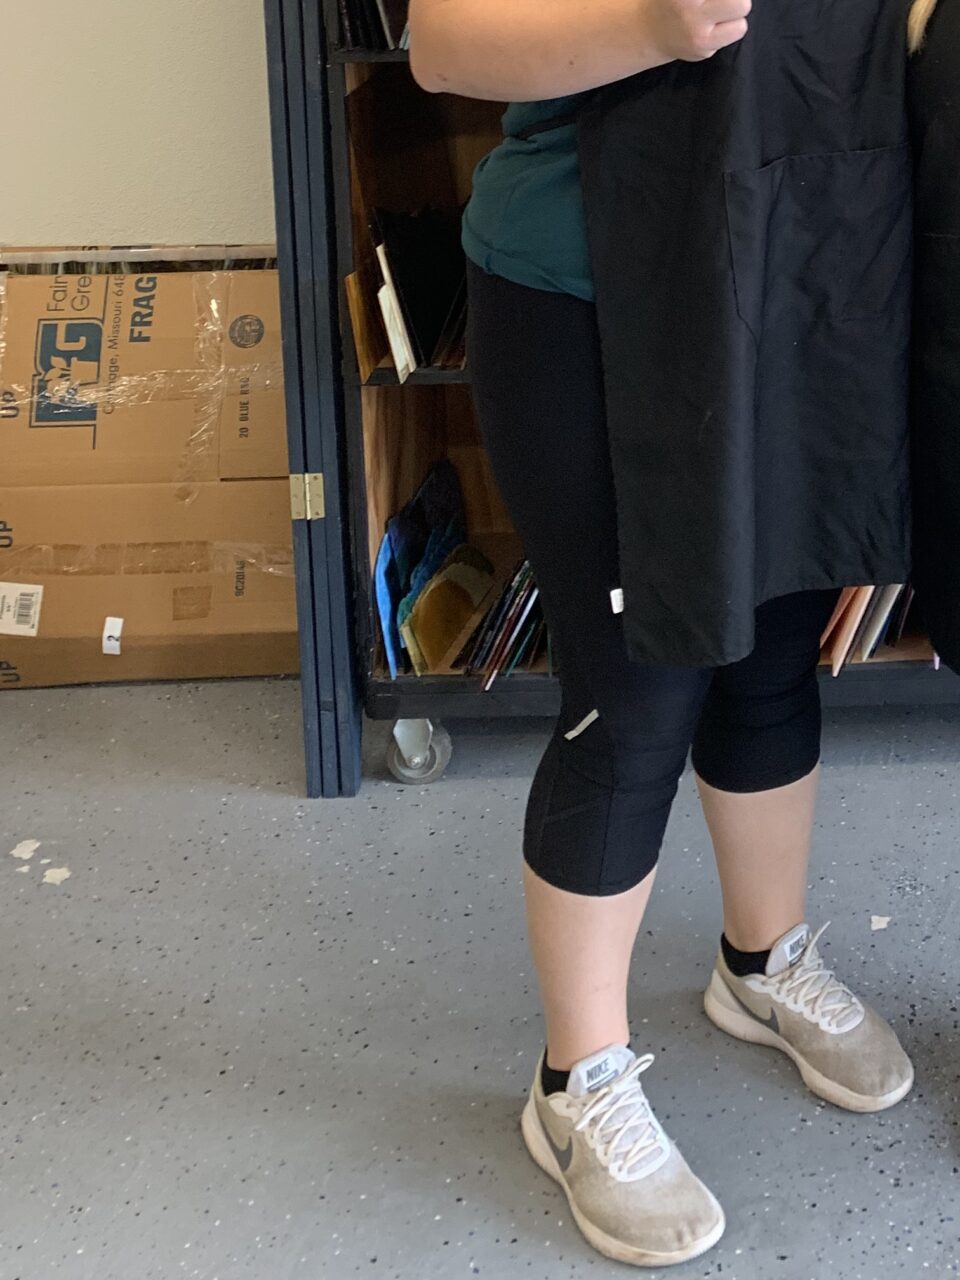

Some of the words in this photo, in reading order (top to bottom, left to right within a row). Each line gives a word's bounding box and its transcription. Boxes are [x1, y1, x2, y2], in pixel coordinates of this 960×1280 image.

[46, 275, 69, 312] Fair
[128, 275, 158, 343] FRAG
[107, 301, 123, 350] Missouri
[1, 390, 20, 418] UP
[0, 520, 13, 548] UP
[0, 661, 20, 683] UP
[586, 1057, 611, 1084] NIKE
